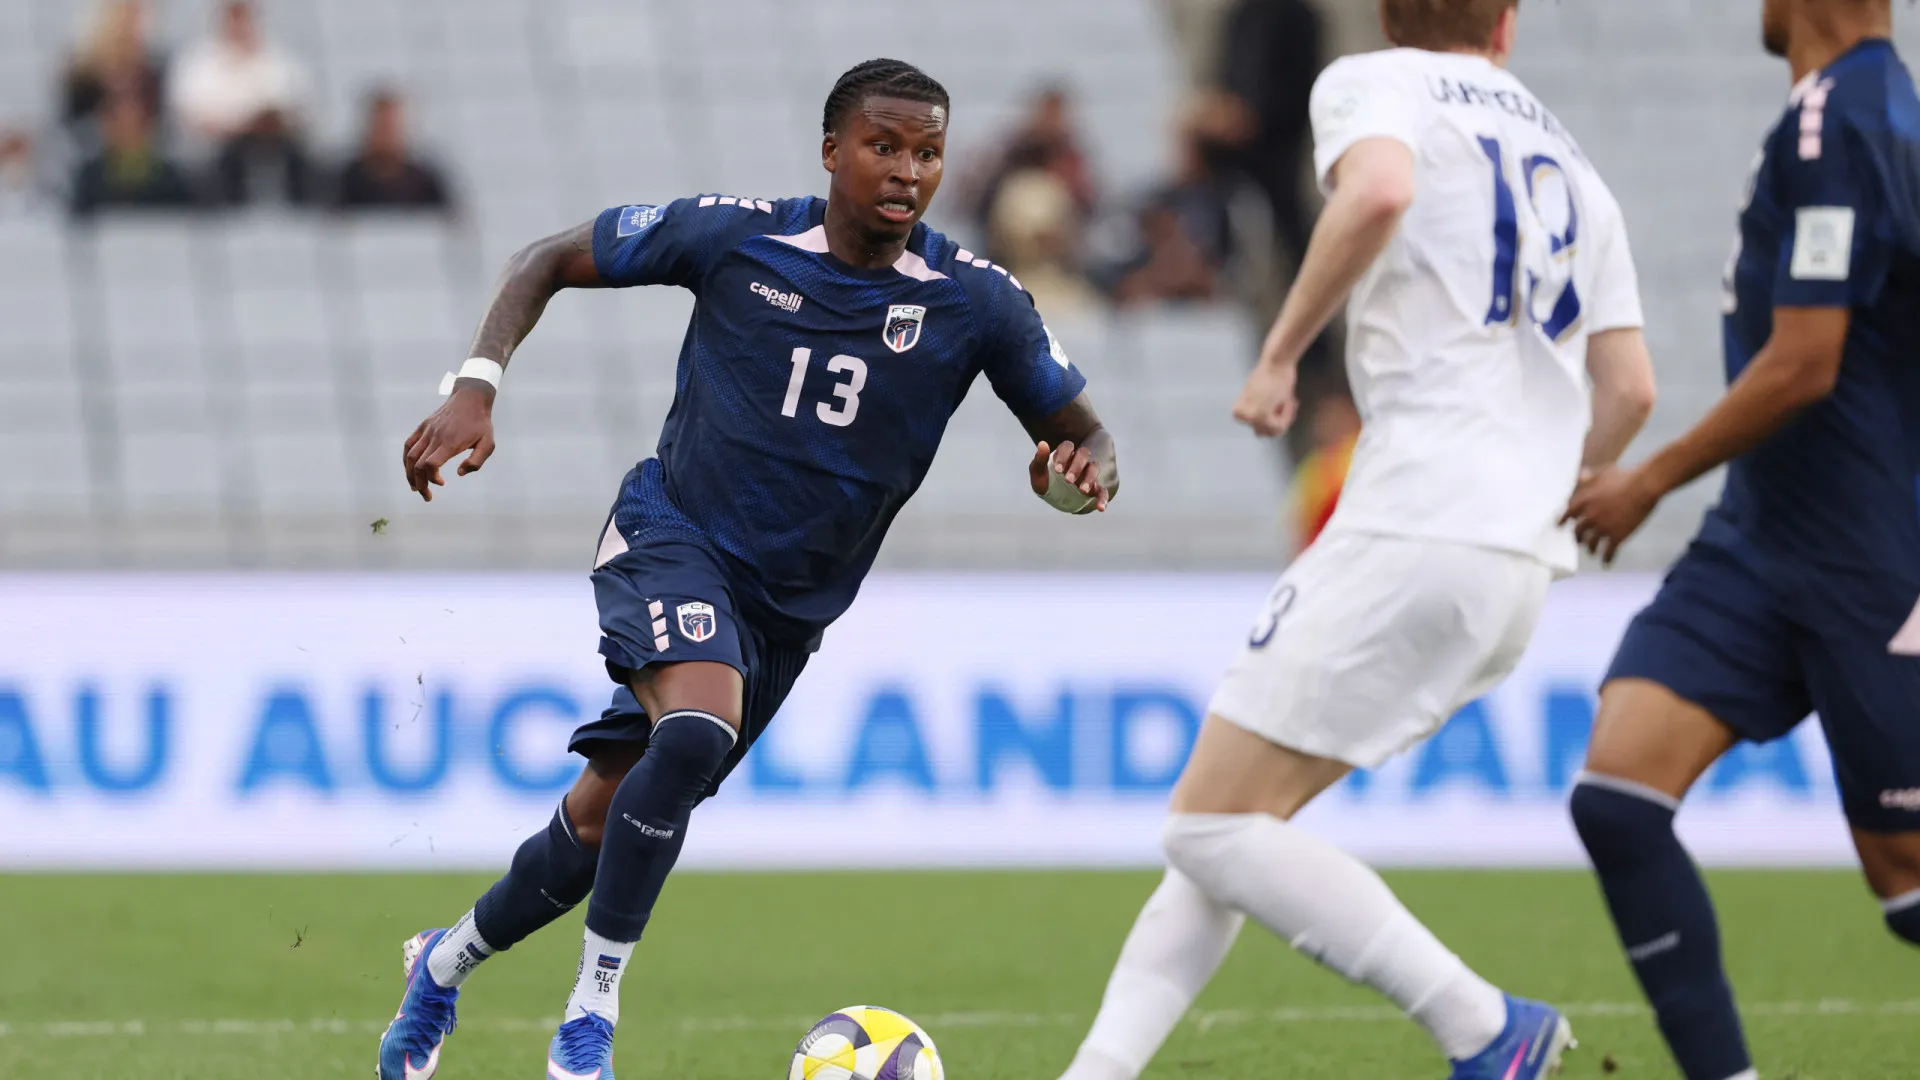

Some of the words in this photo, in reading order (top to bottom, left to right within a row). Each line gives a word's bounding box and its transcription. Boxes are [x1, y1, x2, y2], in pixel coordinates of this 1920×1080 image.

[749, 281, 803, 310] capelli
[770, 299, 799, 314] SPORT
[892, 306, 923, 315] FCF
[780, 346, 869, 427] 13
[681, 603, 711, 611] FCF
[237, 684, 1199, 793] AUCLAND
[455, 962, 467, 974] 15
[594, 970, 617, 983] SLC
[597, 982, 611, 993] 15
